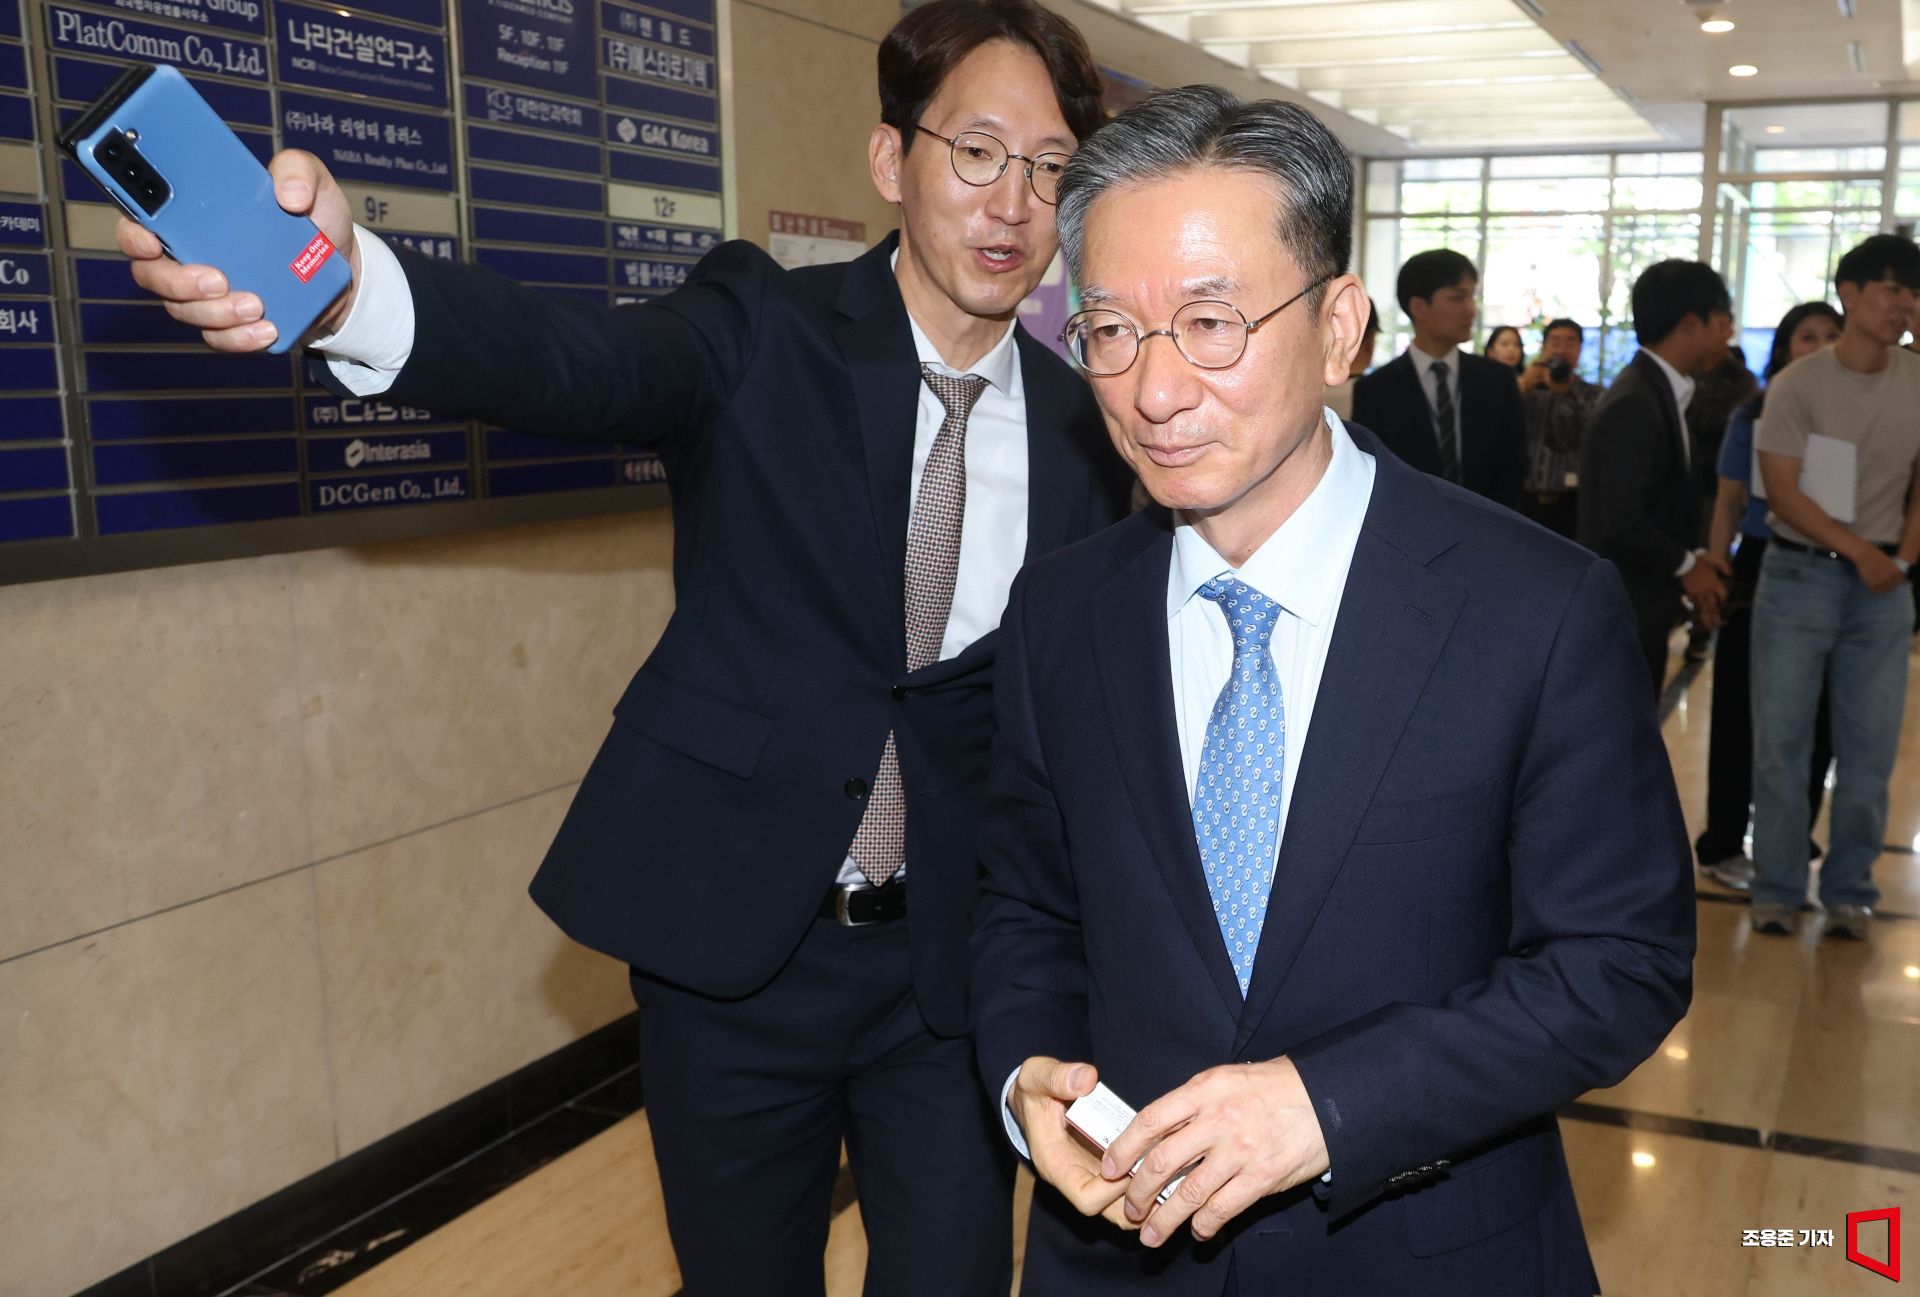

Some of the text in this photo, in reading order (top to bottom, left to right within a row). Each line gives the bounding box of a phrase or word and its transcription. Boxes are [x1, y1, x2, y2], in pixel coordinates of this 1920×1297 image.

[56, 10, 182, 62] PlatComm
[287, 19, 435, 73] 나라건설연구소
[641, 123, 709, 153] GAC Korea
[364, 195, 389, 222] 9F
[654, 197, 676, 217] 12F
[0, 215, 40, 232] 카데미
[294, 253, 311, 270] Keep
[309, 237, 324, 253] Only
[300, 244, 329, 275] Memories
[0, 259, 30, 285] Co
[0, 310, 39, 334] 회사
[364, 439, 432, 462] Interasia
[319, 483, 396, 506] DCGen
[434, 476, 465, 496] Ltd.
